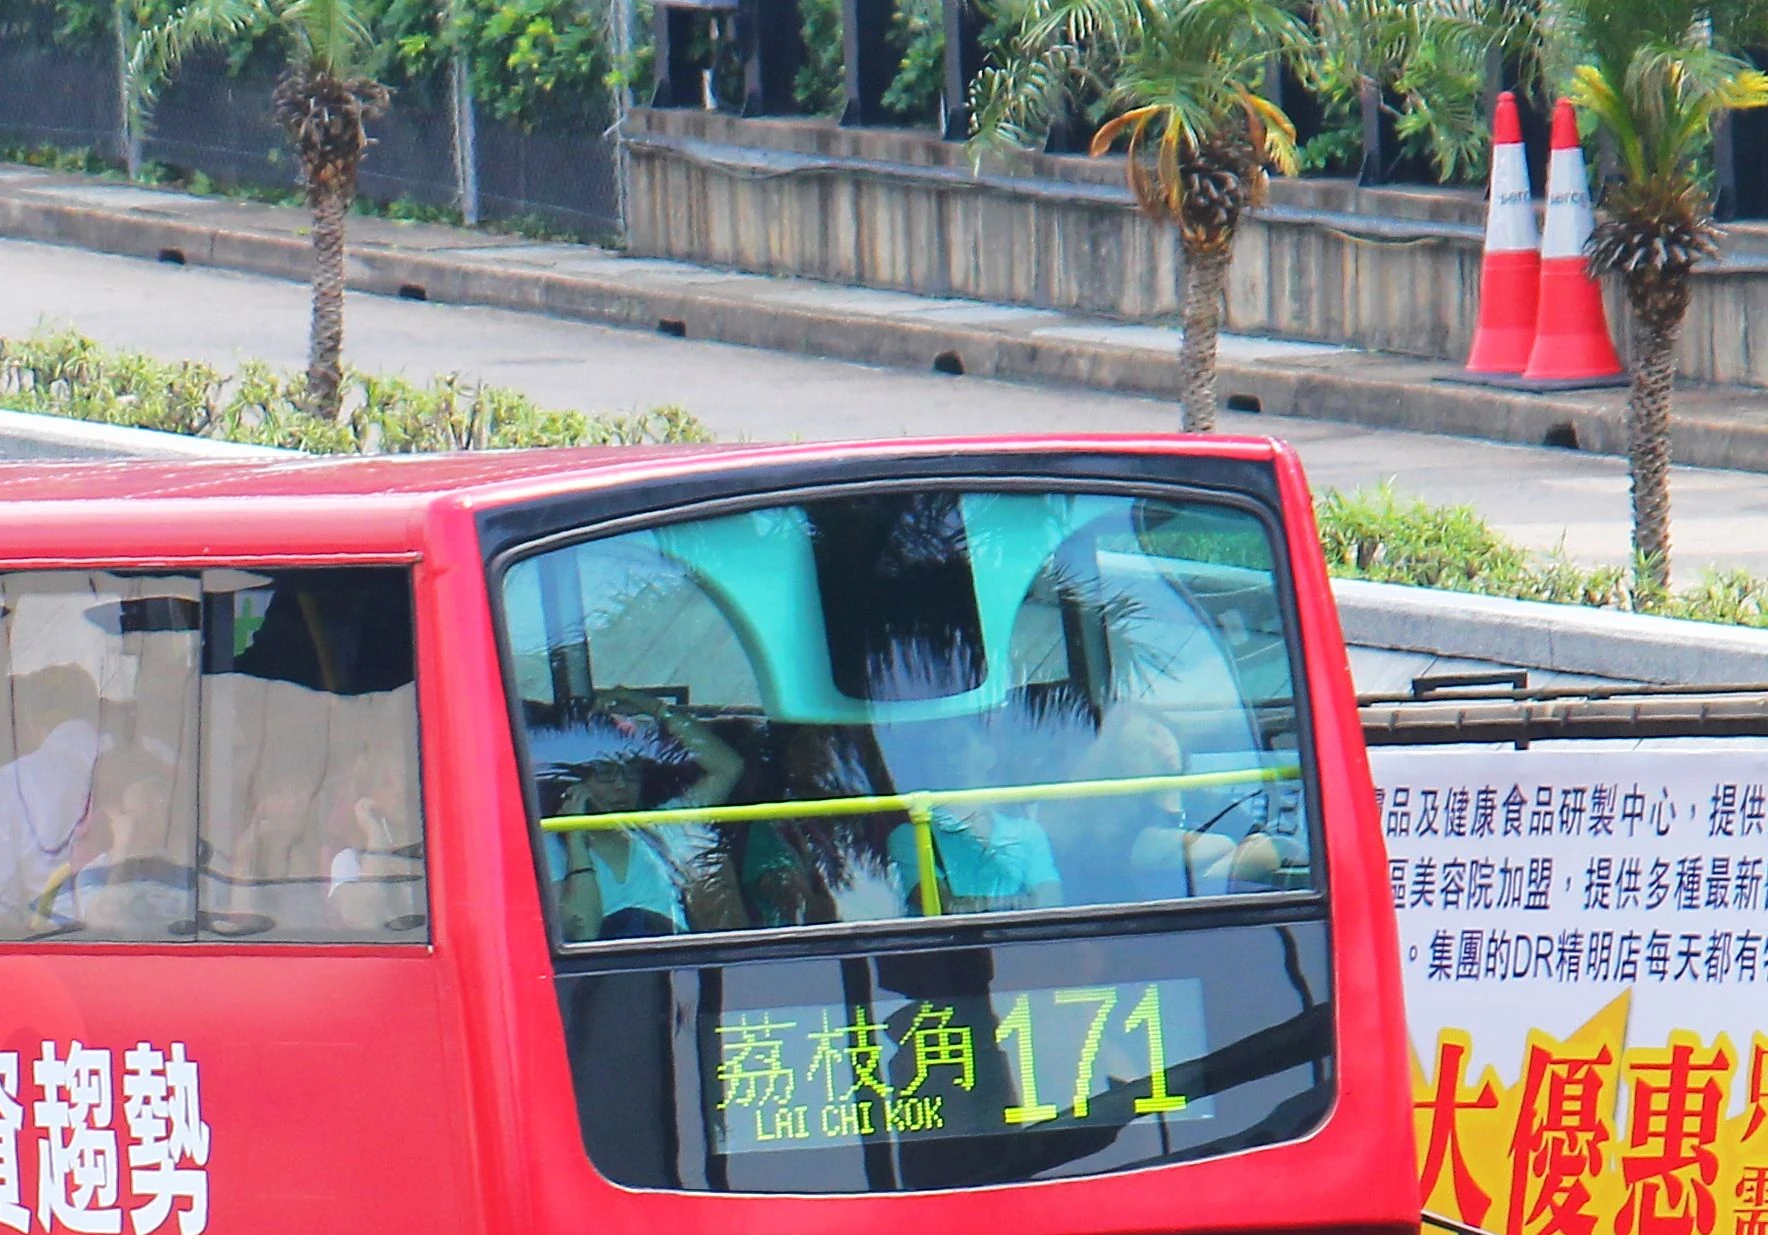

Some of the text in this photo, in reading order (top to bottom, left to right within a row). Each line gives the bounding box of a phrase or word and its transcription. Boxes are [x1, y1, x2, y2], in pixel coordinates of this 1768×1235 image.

[1389, 855, 1768, 911] 區美容院加盟，提供多種最新
[1409, 928, 1768, 984] 。集團的DR精明店每天都有
[715, 1000, 976, 1110] 荔枝角
[995, 985, 1187, 1125] 171
[756, 1096, 944, 1141] LAI CHI KOK
